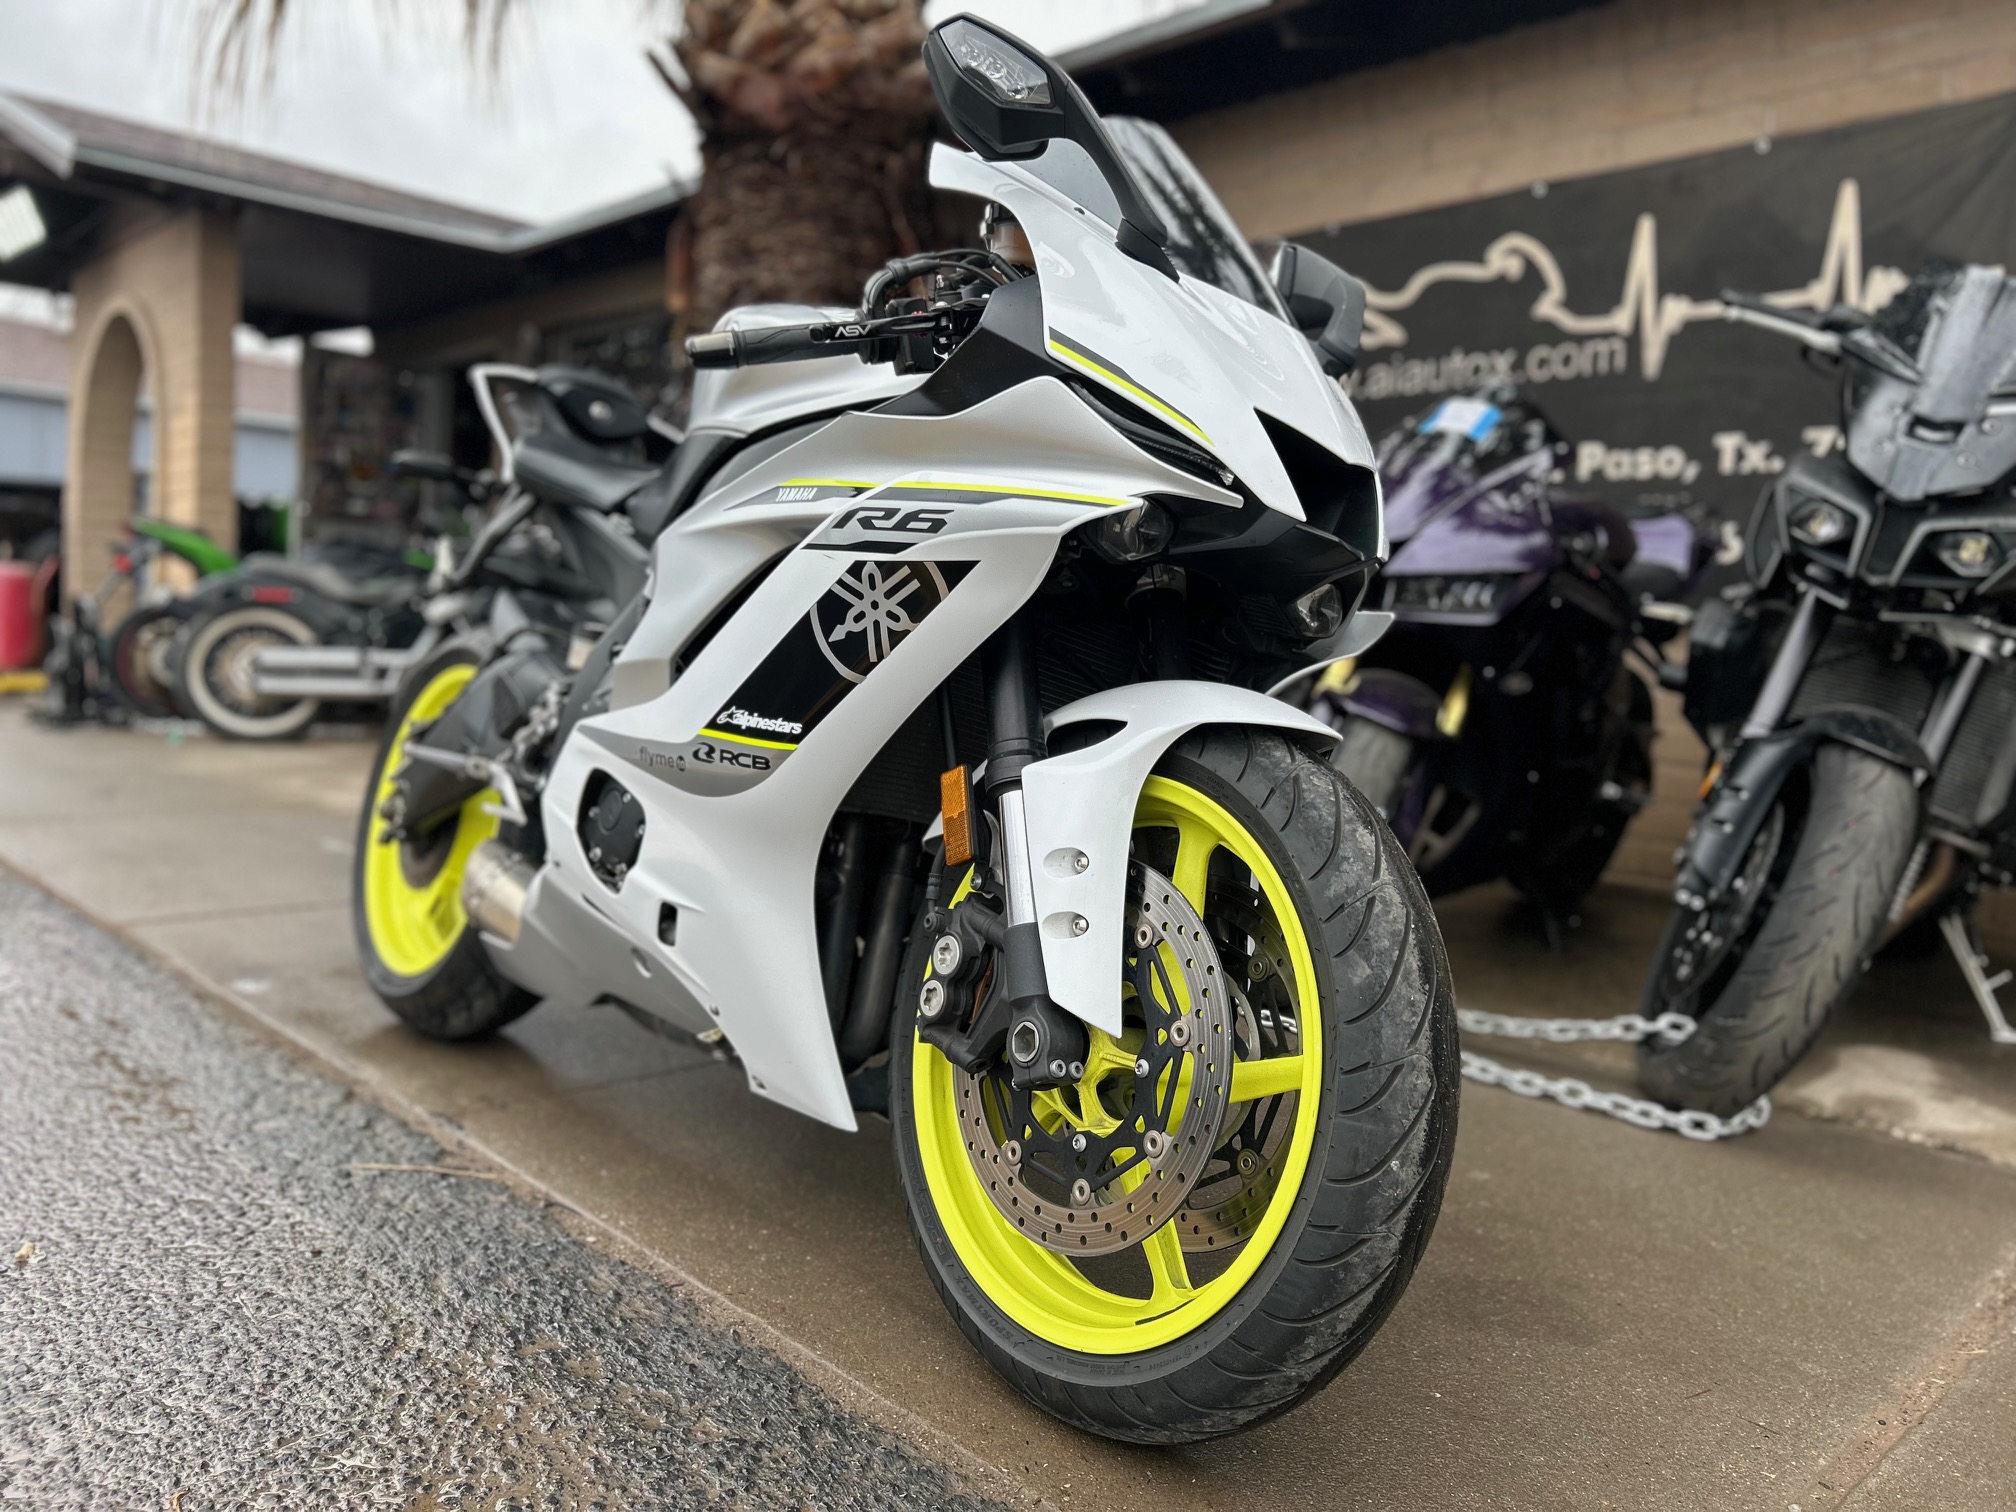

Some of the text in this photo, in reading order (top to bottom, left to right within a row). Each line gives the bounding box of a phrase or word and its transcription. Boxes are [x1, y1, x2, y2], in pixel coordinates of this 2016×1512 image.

[834, 324, 872, 339] ASV
[1574, 438, 1701, 485] Paso,
[1712, 429, 1787, 476] Tx.
[776, 487, 818, 502] YAMAHA
[831, 506, 955, 534] R6
[734, 711, 803, 735] alpinestars
[639, 746, 675, 768] flyme
[719, 749, 771, 771] RCB
